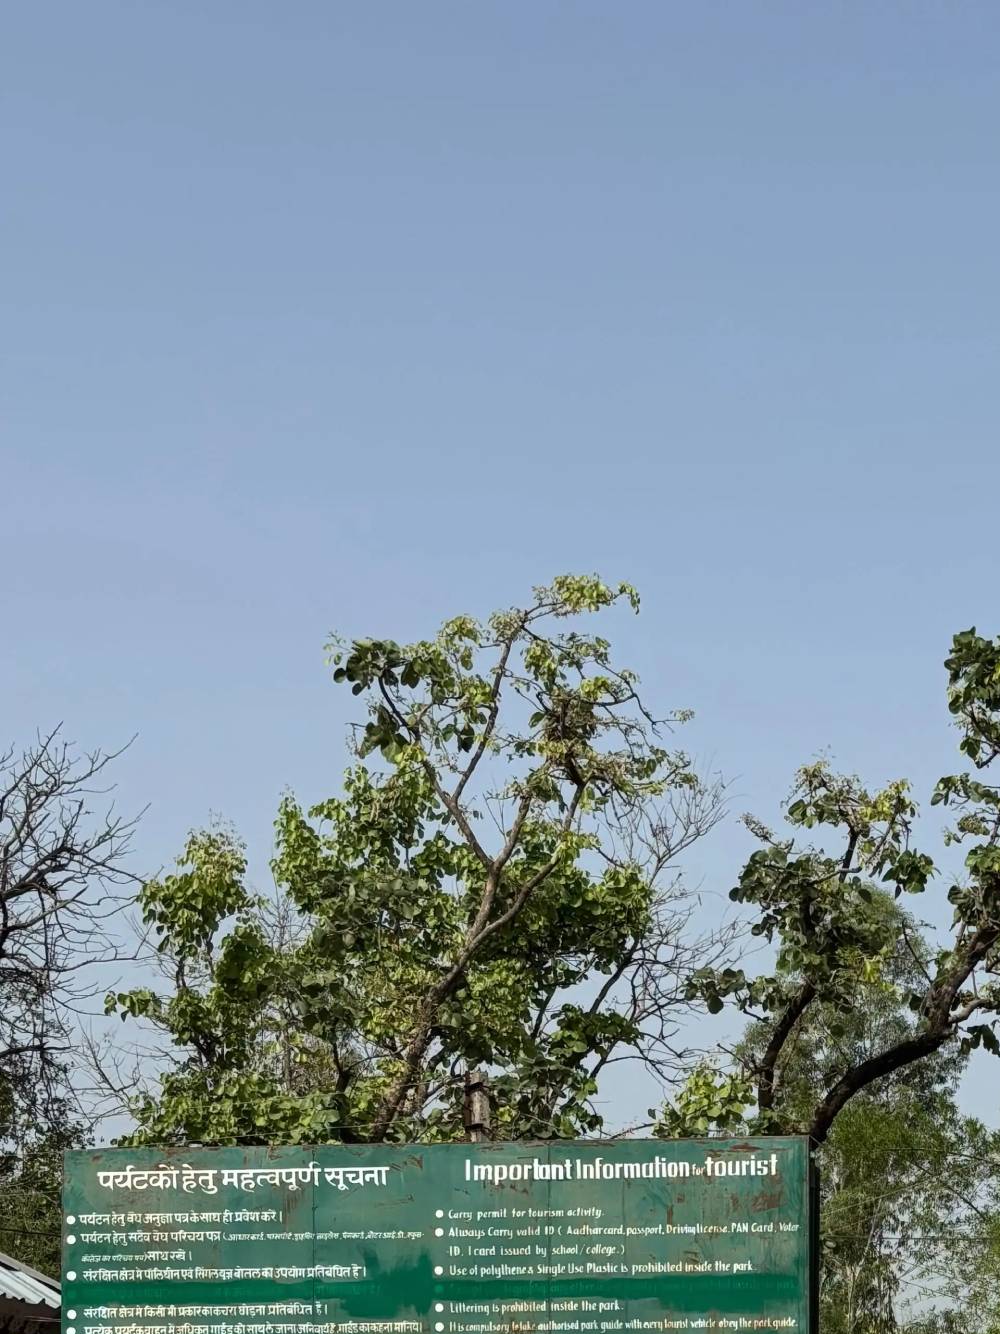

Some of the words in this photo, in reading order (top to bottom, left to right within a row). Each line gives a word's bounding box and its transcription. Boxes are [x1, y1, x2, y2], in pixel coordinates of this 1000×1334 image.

[97, 1164, 179, 1191] पर्यटकों
[182, 1164, 218, 1194] हेतु
[221, 1161, 321, 1193] महत्वपूर्ण
[324, 1166, 390, 1191] सूचना
[465, 1159, 573, 1186] Important
[576, 1156, 691, 1180] Information
[705, 1154, 778, 1177] tourist
[111, 1211, 125, 1227] हेतु
[448, 1209, 473, 1221] Carry
[477, 1208, 507, 1221] permit
[512, 1208, 526, 1217] for
[528, 1208, 564, 1217] tourism
[567, 1207, 605, 1219] activity.
[450, 1302, 490, 1315] Littering
[492, 1304, 500, 1313] is
[501, 1300, 547, 1315] prohibited
[551, 1300, 578, 1311] inside
[581, 1300, 597, 1311] the
